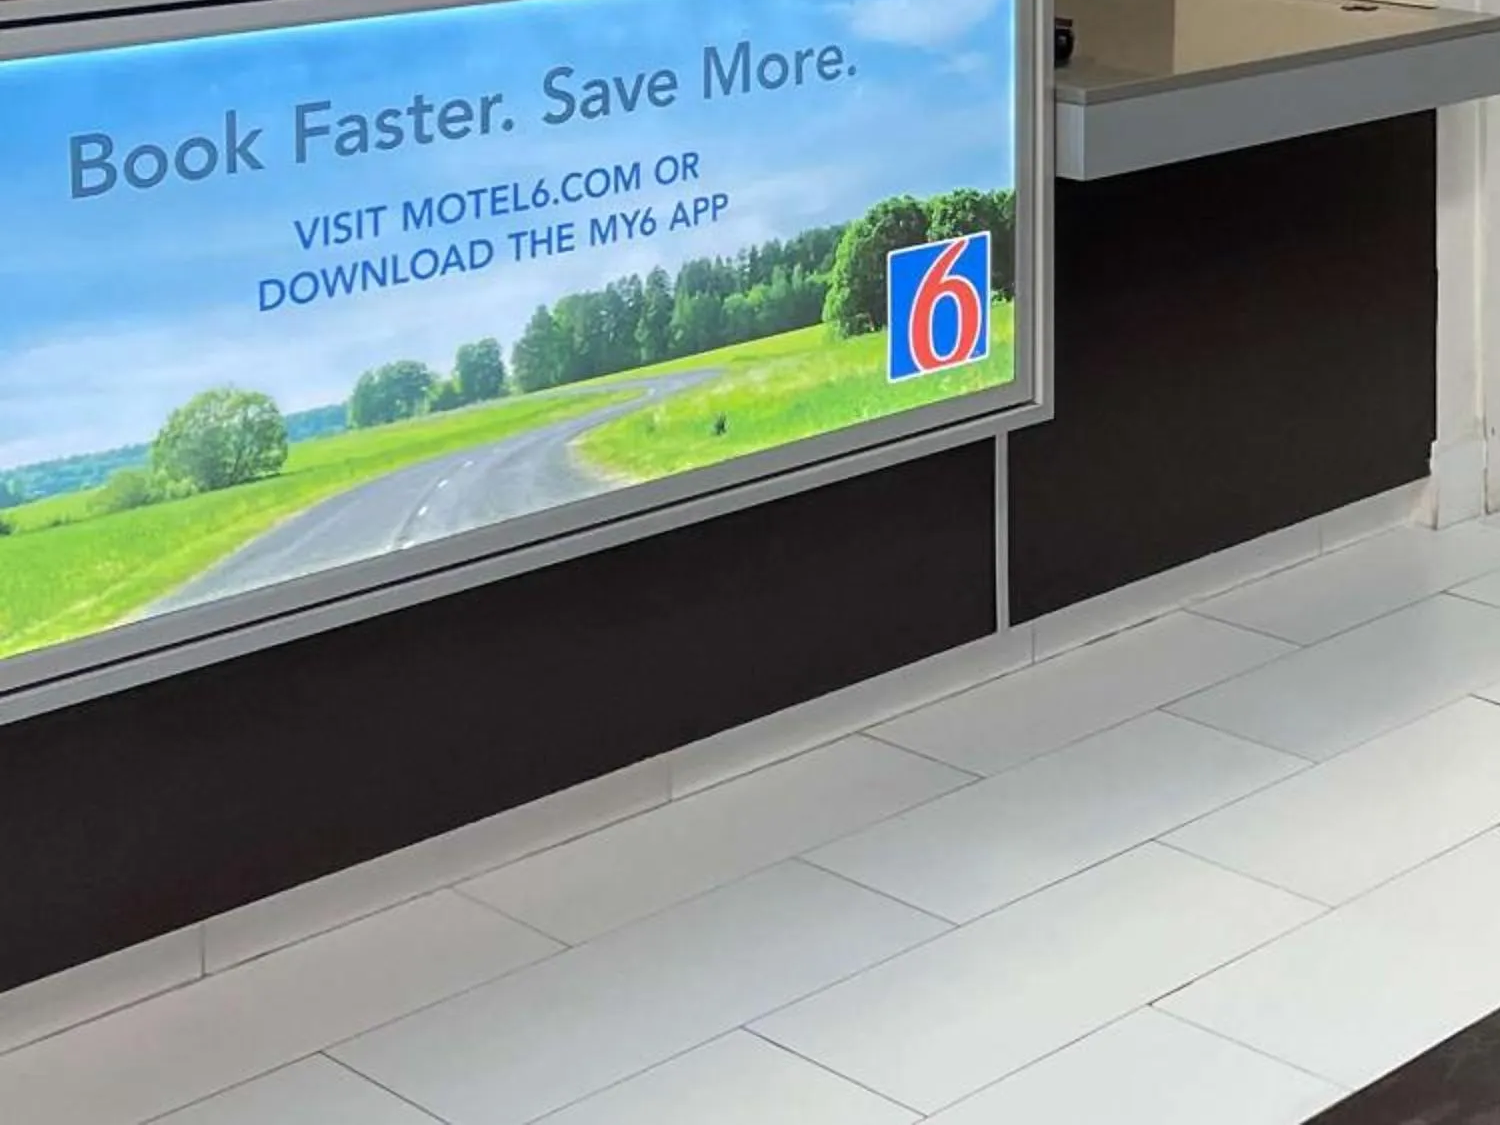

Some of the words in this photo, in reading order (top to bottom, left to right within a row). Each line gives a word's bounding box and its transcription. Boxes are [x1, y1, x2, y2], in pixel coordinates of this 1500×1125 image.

[70, 109, 265, 200] Book
[296, 94, 515, 164] Faster.
[542, 66, 678, 125] Save
[703, 41, 857, 100] More.
[258, 238, 495, 312] DOWNLOAD
[506, 222, 576, 262] THE
[589, 206, 659, 247] MY6
[668, 192, 729, 232] APP
[293, 204, 388, 250] VISIT
[402, 161, 641, 232] MOTEL6.COM
[653, 151, 700, 186] OR
[907, 236, 984, 375] 6
